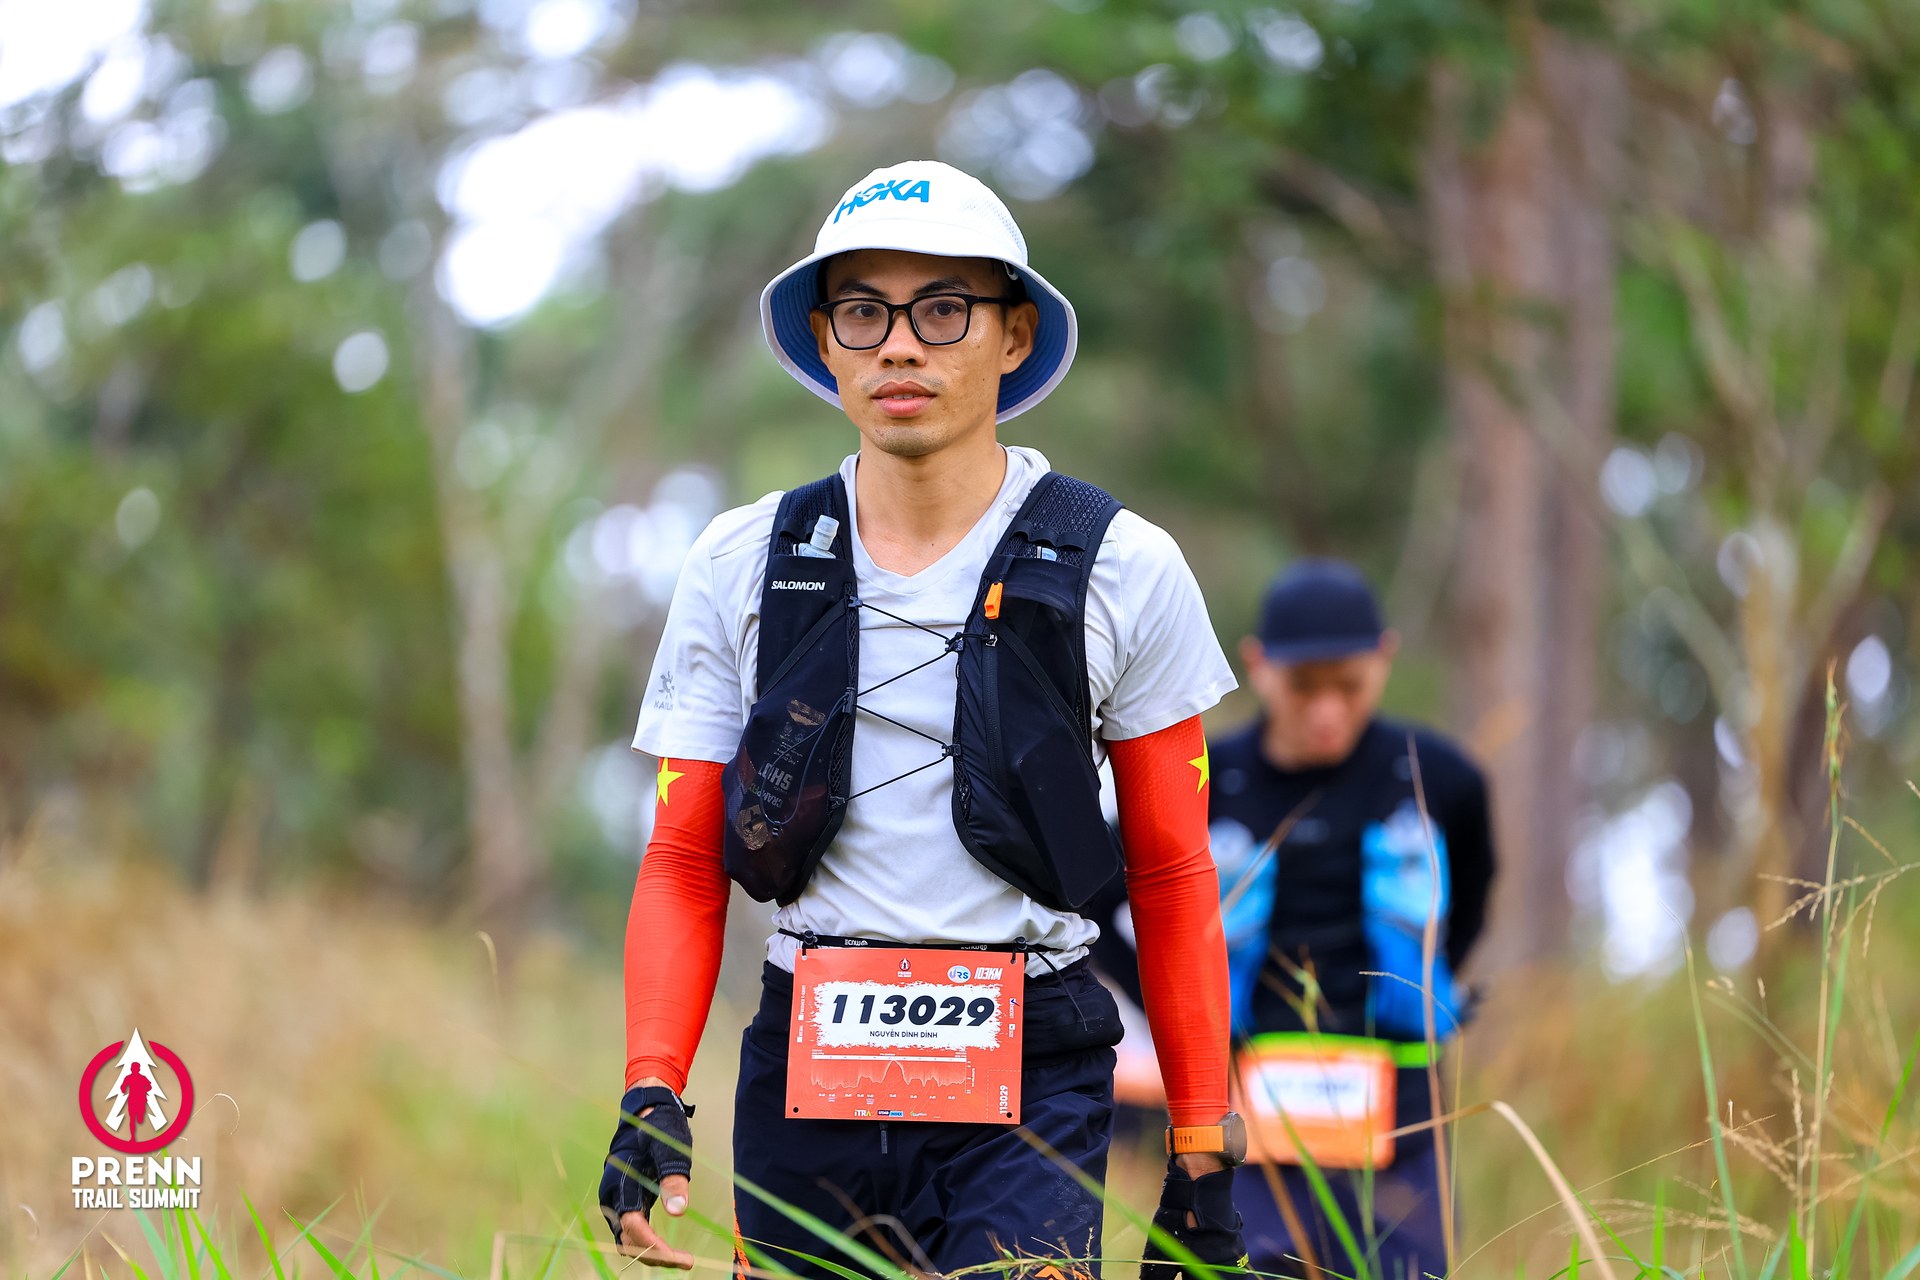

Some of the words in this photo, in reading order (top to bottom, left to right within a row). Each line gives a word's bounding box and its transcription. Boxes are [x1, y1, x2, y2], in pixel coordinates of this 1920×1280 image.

[833, 179, 930, 224] HOKA
[771, 580, 826, 591] SALOMON
[832, 994, 995, 1027] 113029
[999, 1084, 1009, 1115] 113029
